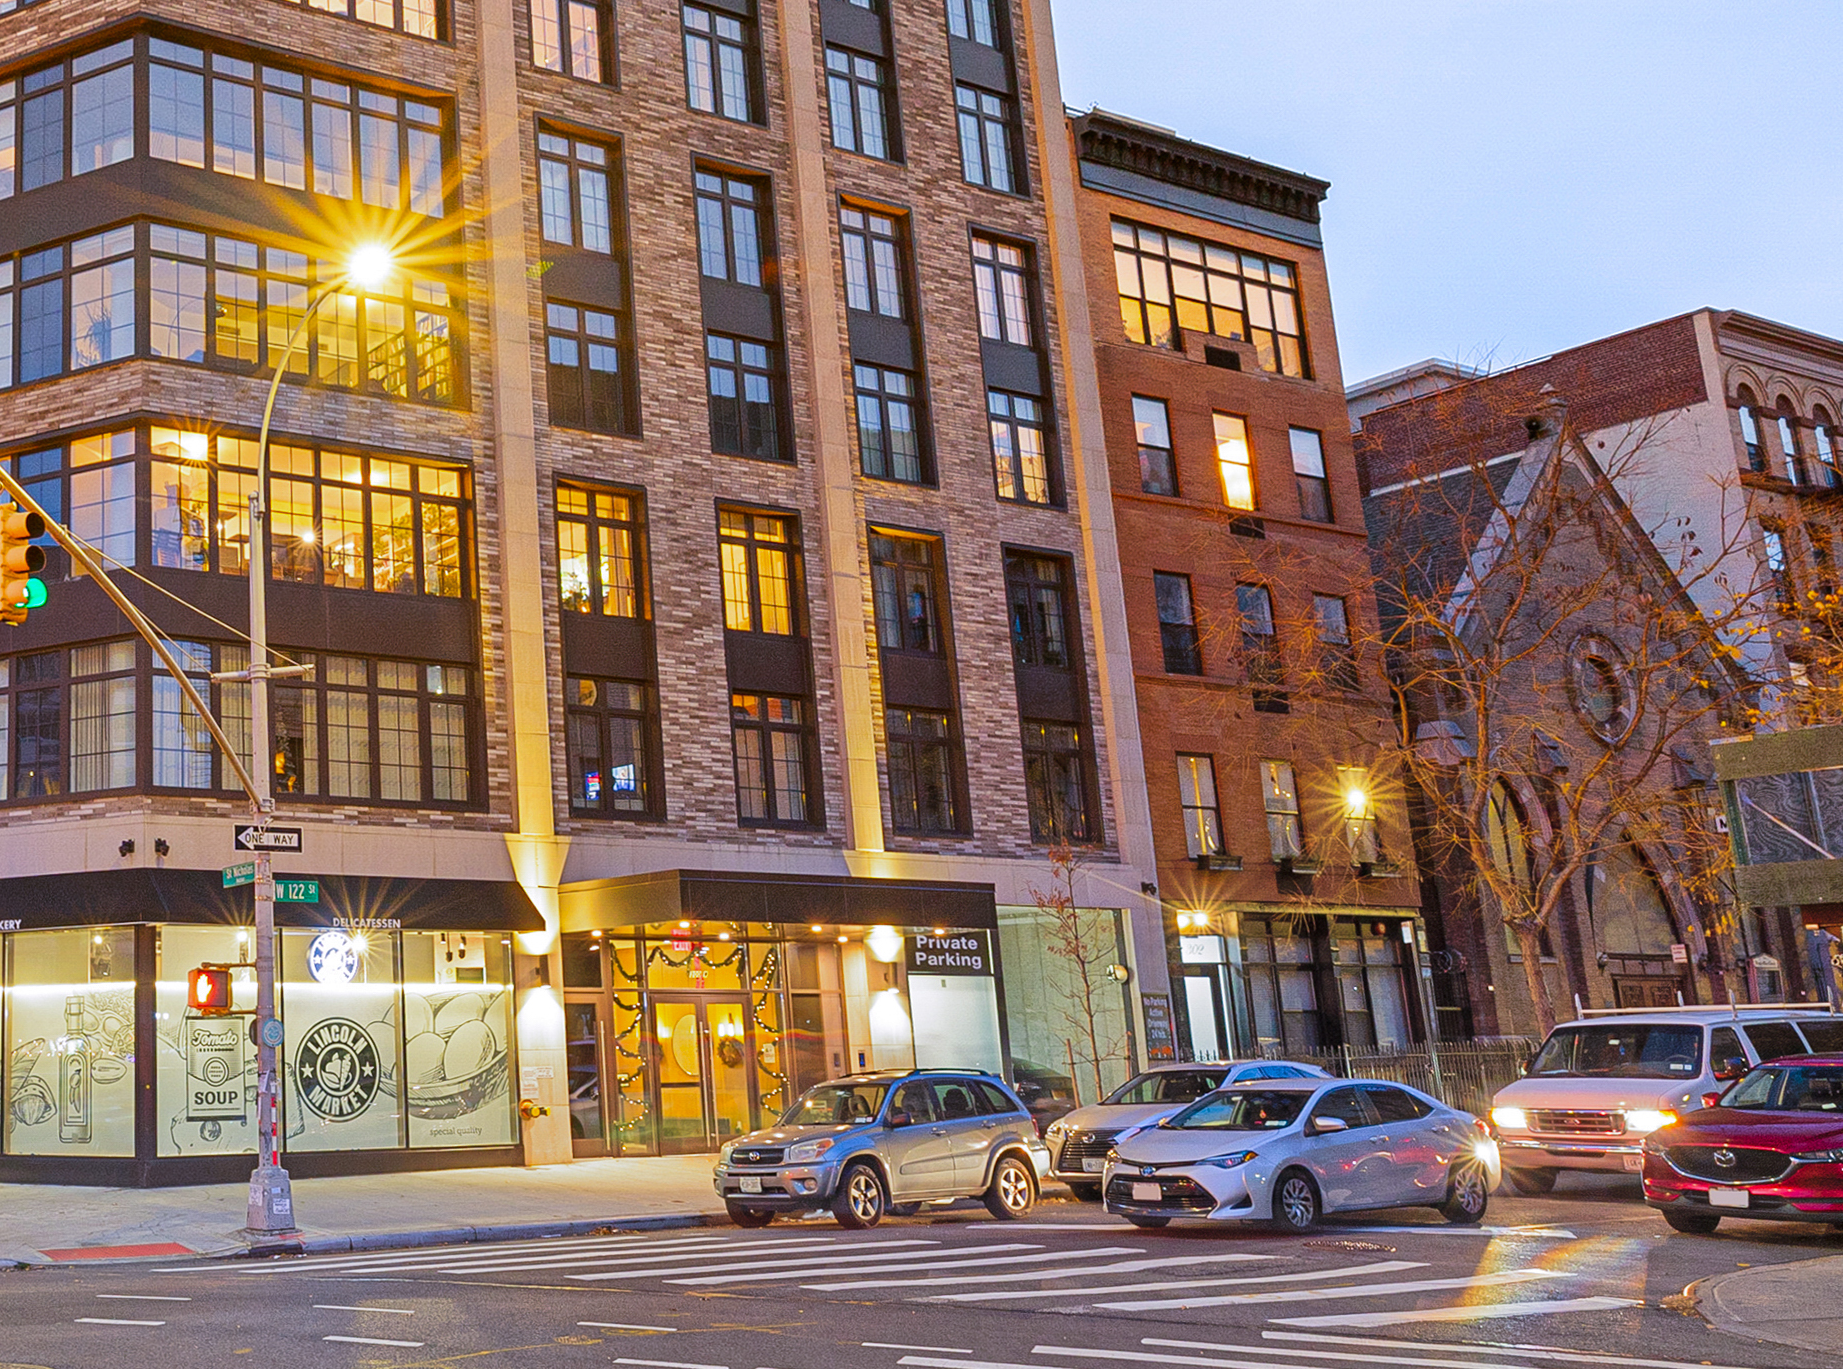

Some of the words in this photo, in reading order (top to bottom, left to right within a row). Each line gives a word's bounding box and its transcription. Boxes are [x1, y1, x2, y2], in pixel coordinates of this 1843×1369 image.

[245, 833, 264, 844] ONE
[273, 834, 294, 845] WAY
[276, 884, 284, 898] W
[288, 883, 305, 899] 122
[308, 884, 316, 894] St
[332, 917, 401, 928] DELICATESSEN
[916, 934, 978, 950] Private
[915, 952, 982, 970] Parking
[191, 1028, 239, 1046] Tomato
[307, 1024, 368, 1056] LINCOLN
[194, 1091, 238, 1105] SOUP
[308, 1084, 369, 1116] MARKET
[457, 1126, 482, 1136] quality
